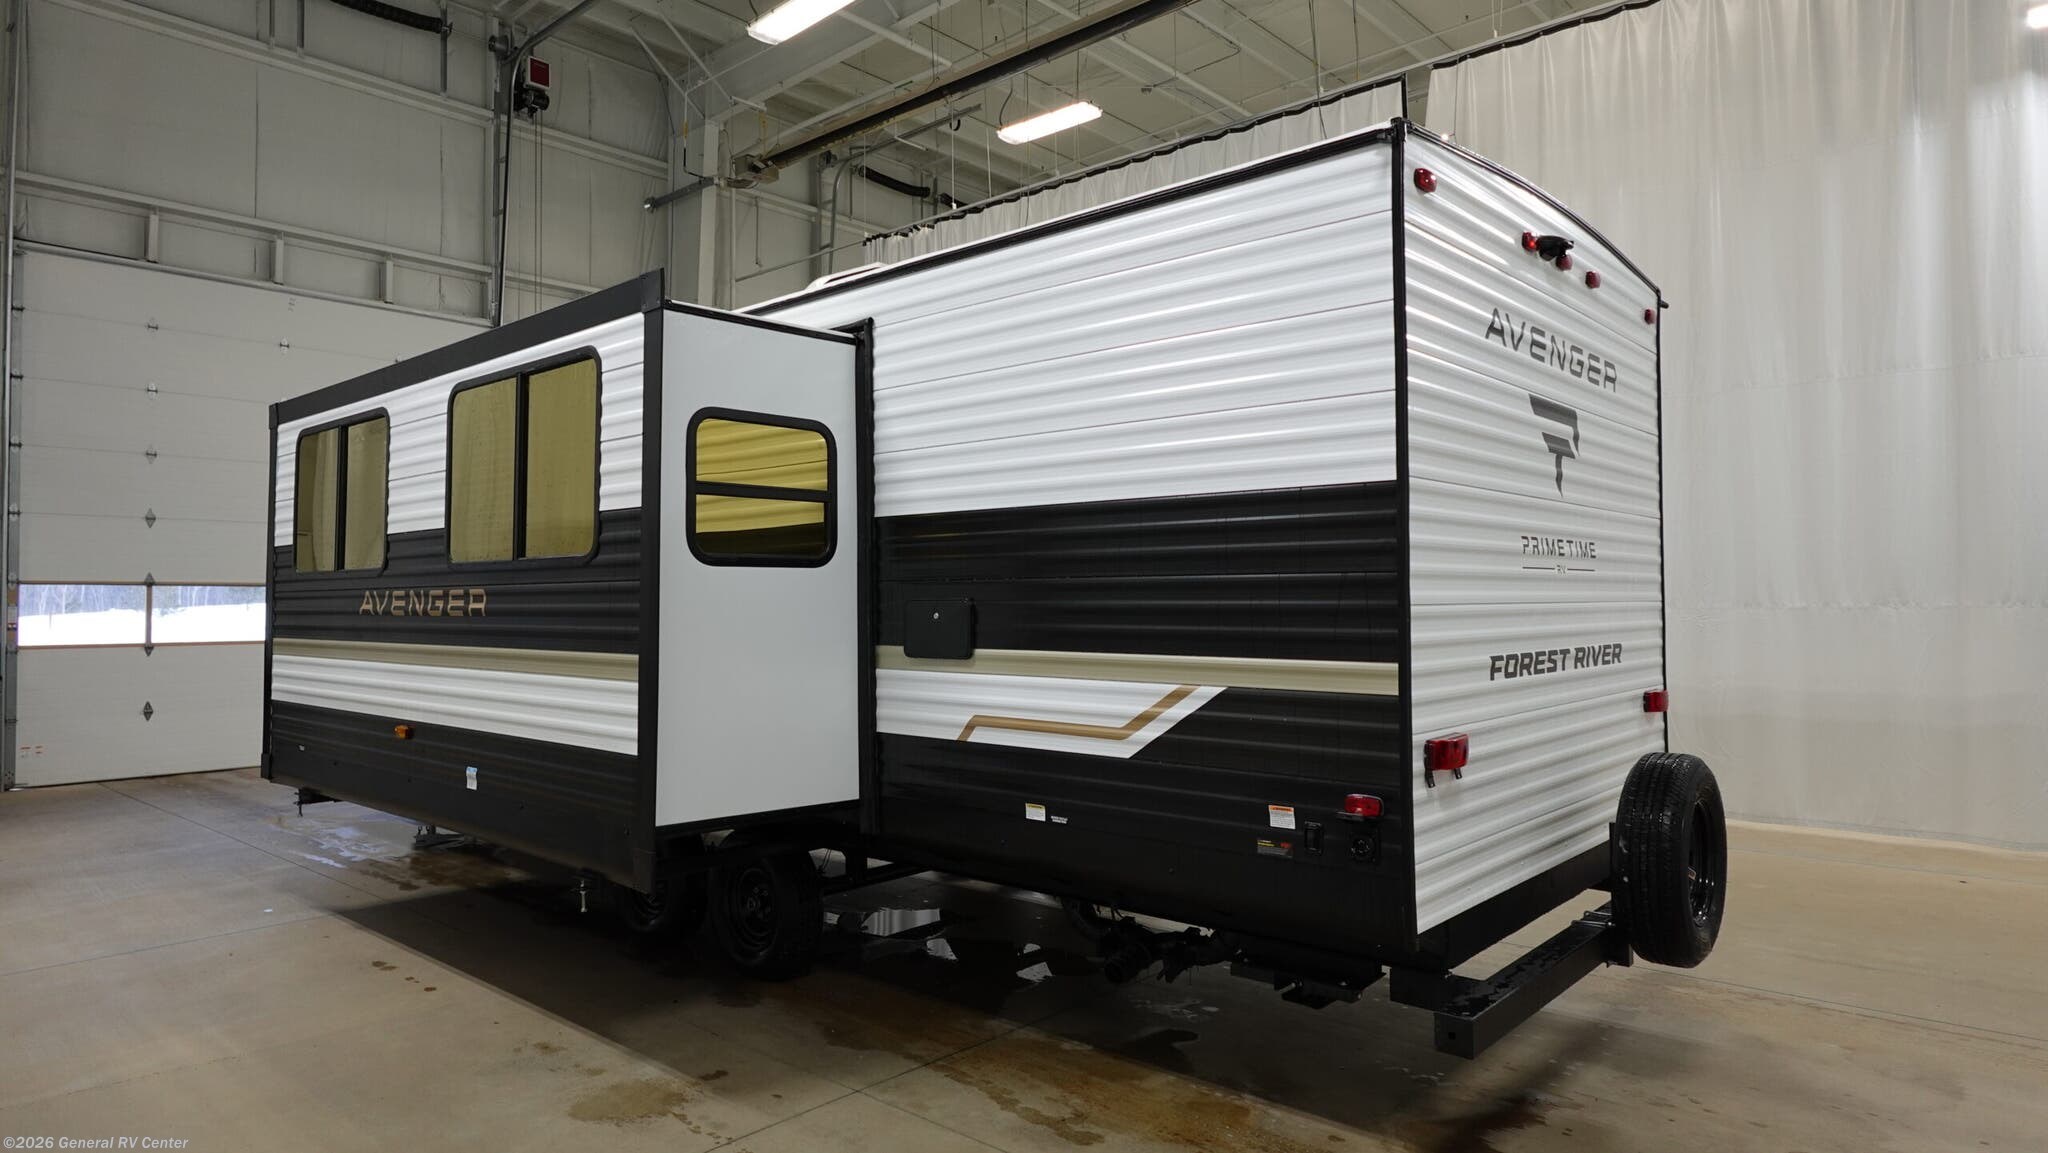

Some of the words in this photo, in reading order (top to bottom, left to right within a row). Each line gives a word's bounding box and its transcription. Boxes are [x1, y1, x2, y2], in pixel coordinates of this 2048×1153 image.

[1485, 308, 1617, 392] AVENGER
[1521, 535, 1597, 559] PRIMETIME
[360, 588, 486, 617] AVENGER
[1489, 648, 1571, 681] FOREST
[1573, 643, 1623, 670] RIVER
